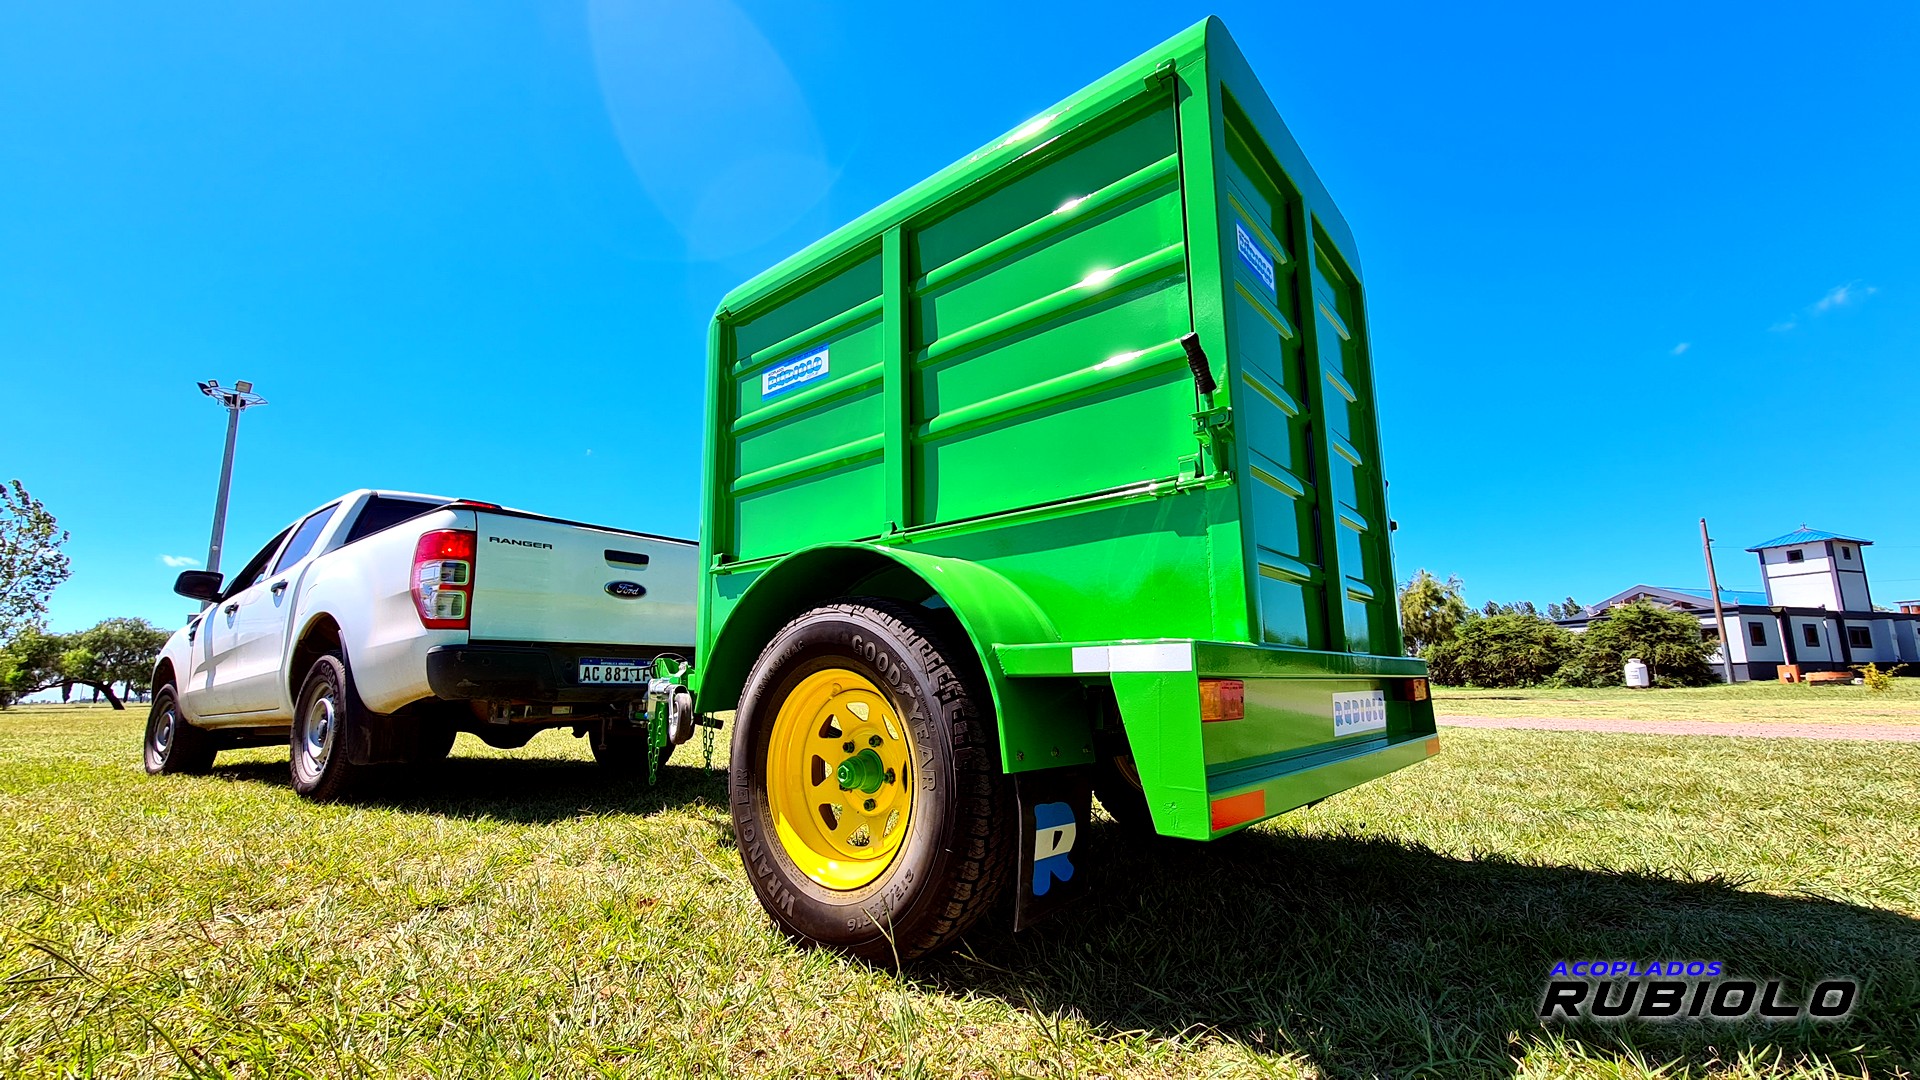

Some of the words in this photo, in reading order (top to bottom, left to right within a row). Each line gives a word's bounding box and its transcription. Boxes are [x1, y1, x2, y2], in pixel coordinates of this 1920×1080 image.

[489, 536, 552, 550] RANGER
[616, 583, 640, 595] Ford
[583, 666, 600, 682] AC
[605, 667, 629, 682] 881
[735, 768, 796, 918] WRANGLER
[1032, 802, 1077, 896] R
